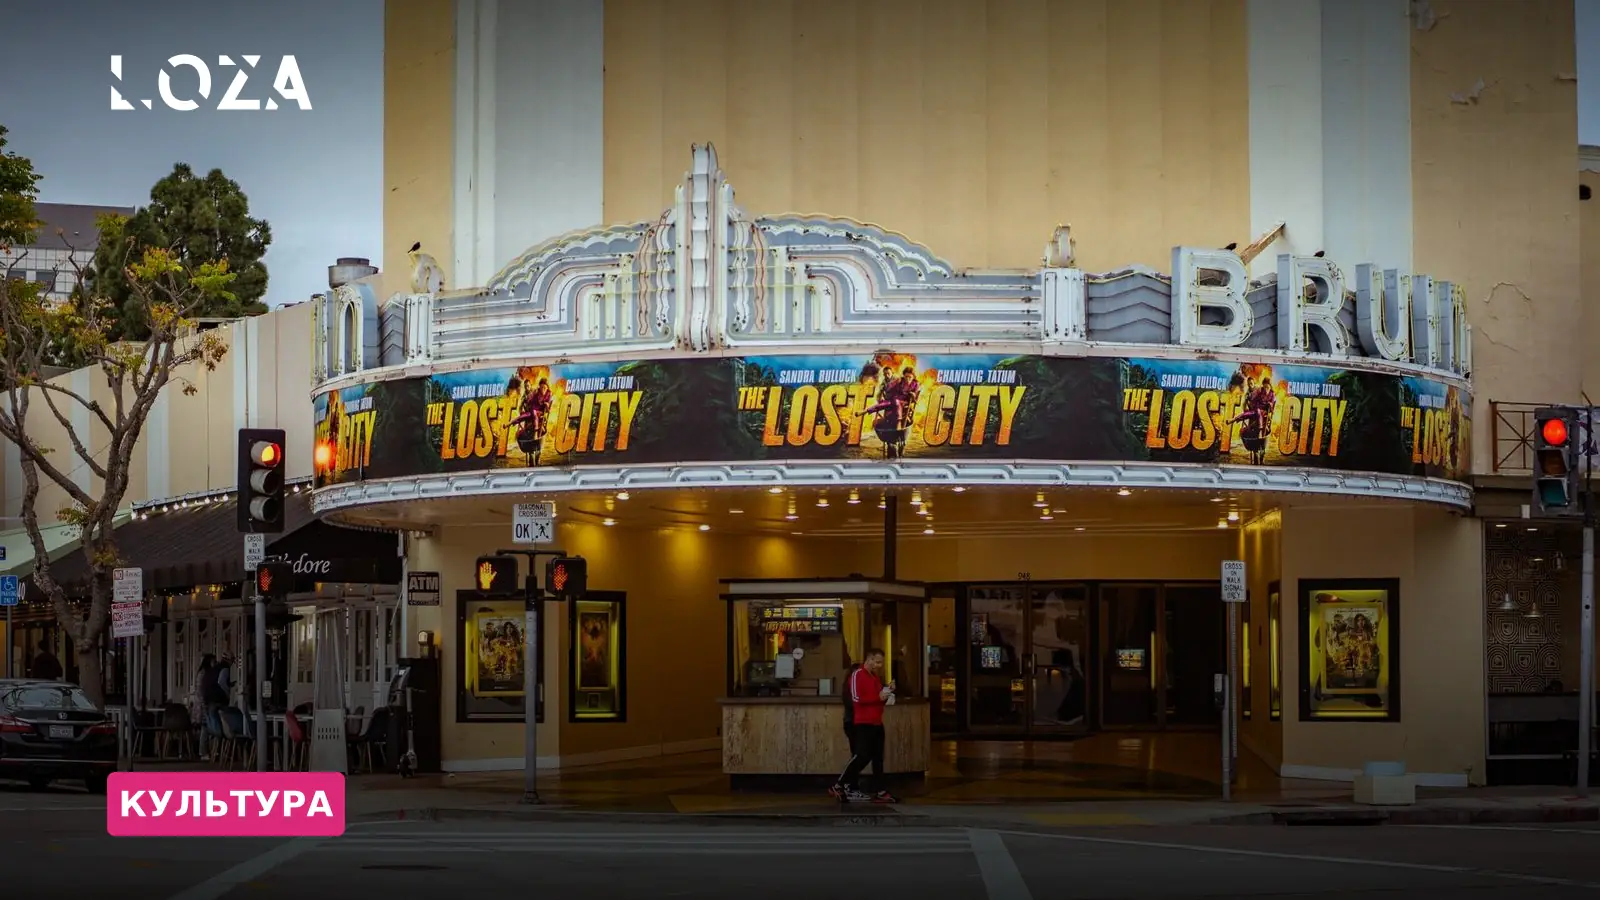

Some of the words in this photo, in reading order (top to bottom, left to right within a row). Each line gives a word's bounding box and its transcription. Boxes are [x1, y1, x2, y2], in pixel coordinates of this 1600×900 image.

[566, 376, 606, 392] CHANNING
[608, 375, 634, 390] TATUM
[778, 369, 814, 384] SANDRA
[818, 368, 857, 383] BULLOCK
[937, 369, 983, 383] CHANNING
[987, 369, 1016, 384] TATUM
[1161, 374, 1192, 388] SANDRA
[1195, 375, 1228, 391] BULLOCK
[452, 385, 476, 399] SANDRA
[1287, 381, 1320, 396] CHANNING
[1322, 383, 1341, 398] TATUM
[738, 387, 766, 411] THE
[763, 385, 874, 447] LOST
[923, 386, 1026, 447] CITY
[1123, 388, 1149, 412] THE
[1146, 389, 1241, 452] LOST
[1278, 396, 1347, 457] CITY
[1400, 406, 1414, 429] THE
[427, 402, 445, 426] THE
[441, 395, 519, 460] LOST
[555, 391, 643, 455] CITY
[337, 411, 377, 472] CITY
[518, 503, 547, 511] DIAGONAL
[246, 535, 262, 543] CROSS
[515, 523, 530, 539] OK
[1224, 562, 1243, 570] CROSS
[409, 576, 439, 590] ATM
[1226, 591, 1241, 599] ONLY
